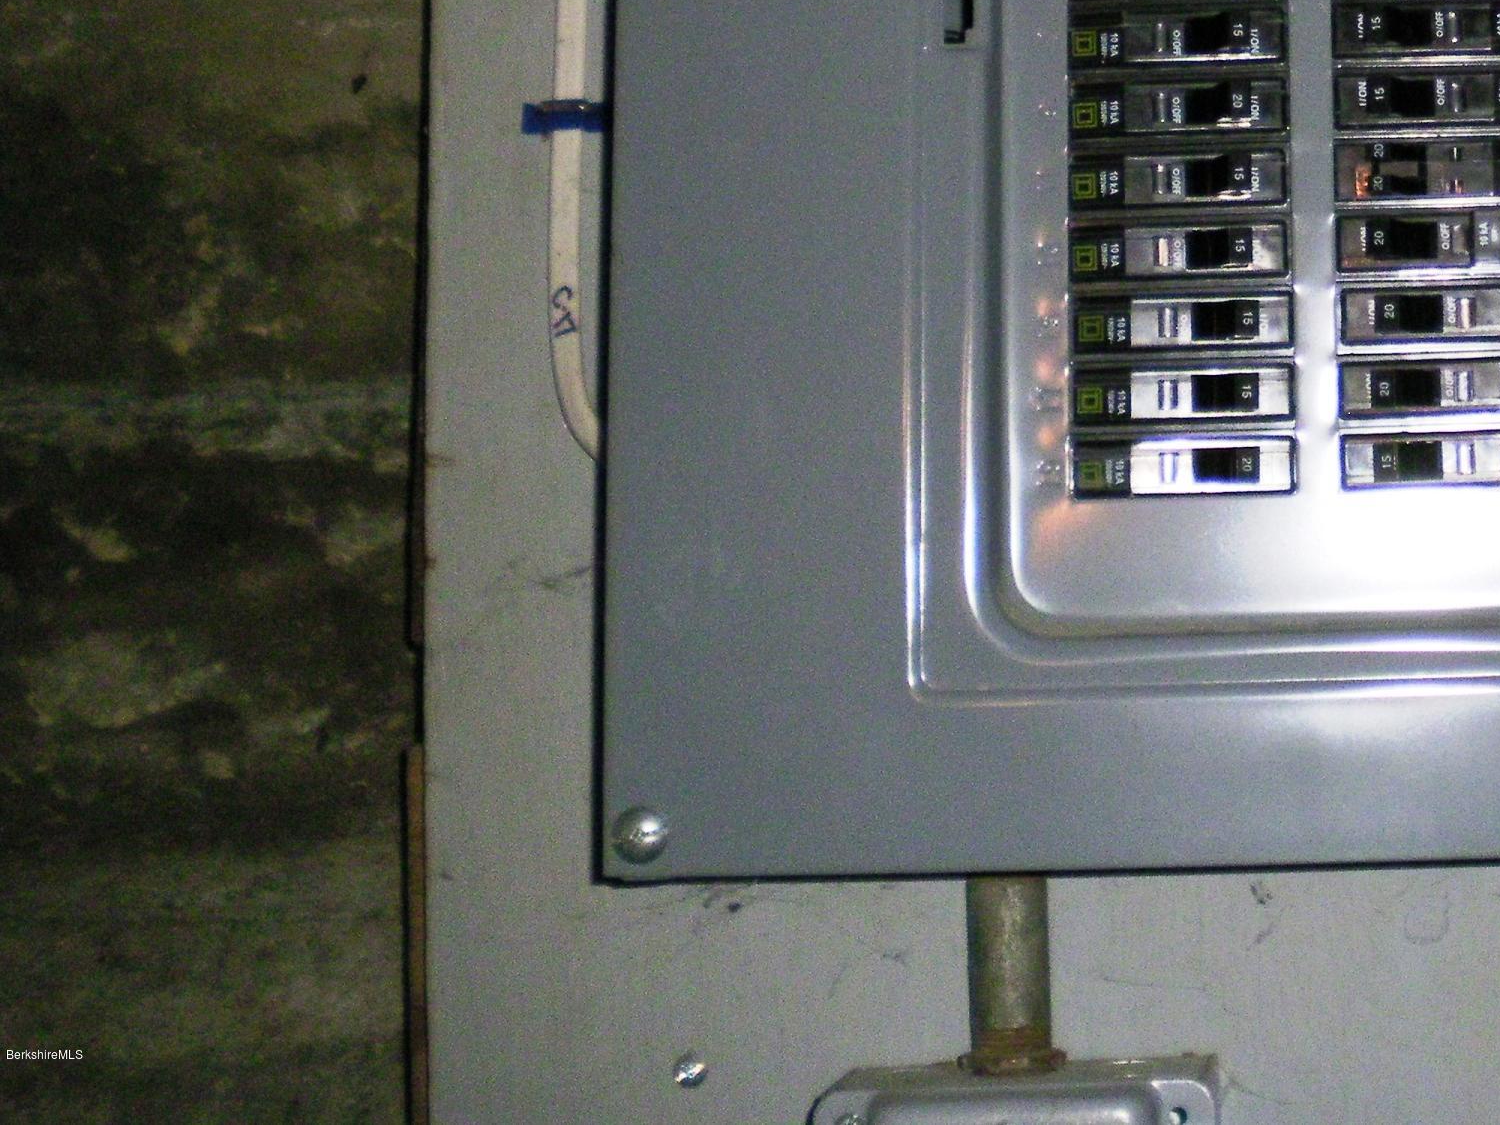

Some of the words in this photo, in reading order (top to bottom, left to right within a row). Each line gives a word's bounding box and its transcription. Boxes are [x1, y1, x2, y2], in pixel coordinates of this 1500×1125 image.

[1233, 23, 1244, 37] 15
[1370, 15, 1382, 30] 15
[1232, 92, 1244, 109] 20
[1358, 80, 1368, 107] I/ON
[1374, 87, 1386, 101] 15
[1373, 143, 1385, 159] 20
[1233, 167, 1244, 181] 15
[1235, 238, 1247, 253] 15
[1374, 230, 1386, 246] 20
[1383, 302, 1396, 319] 20
[1243, 311, 1255, 326] 15
[1241, 385, 1253, 400] 15
[1379, 381, 1391, 397] 20
[1242, 457, 1253, 472] 20
[1382, 454, 1393, 470] 15
